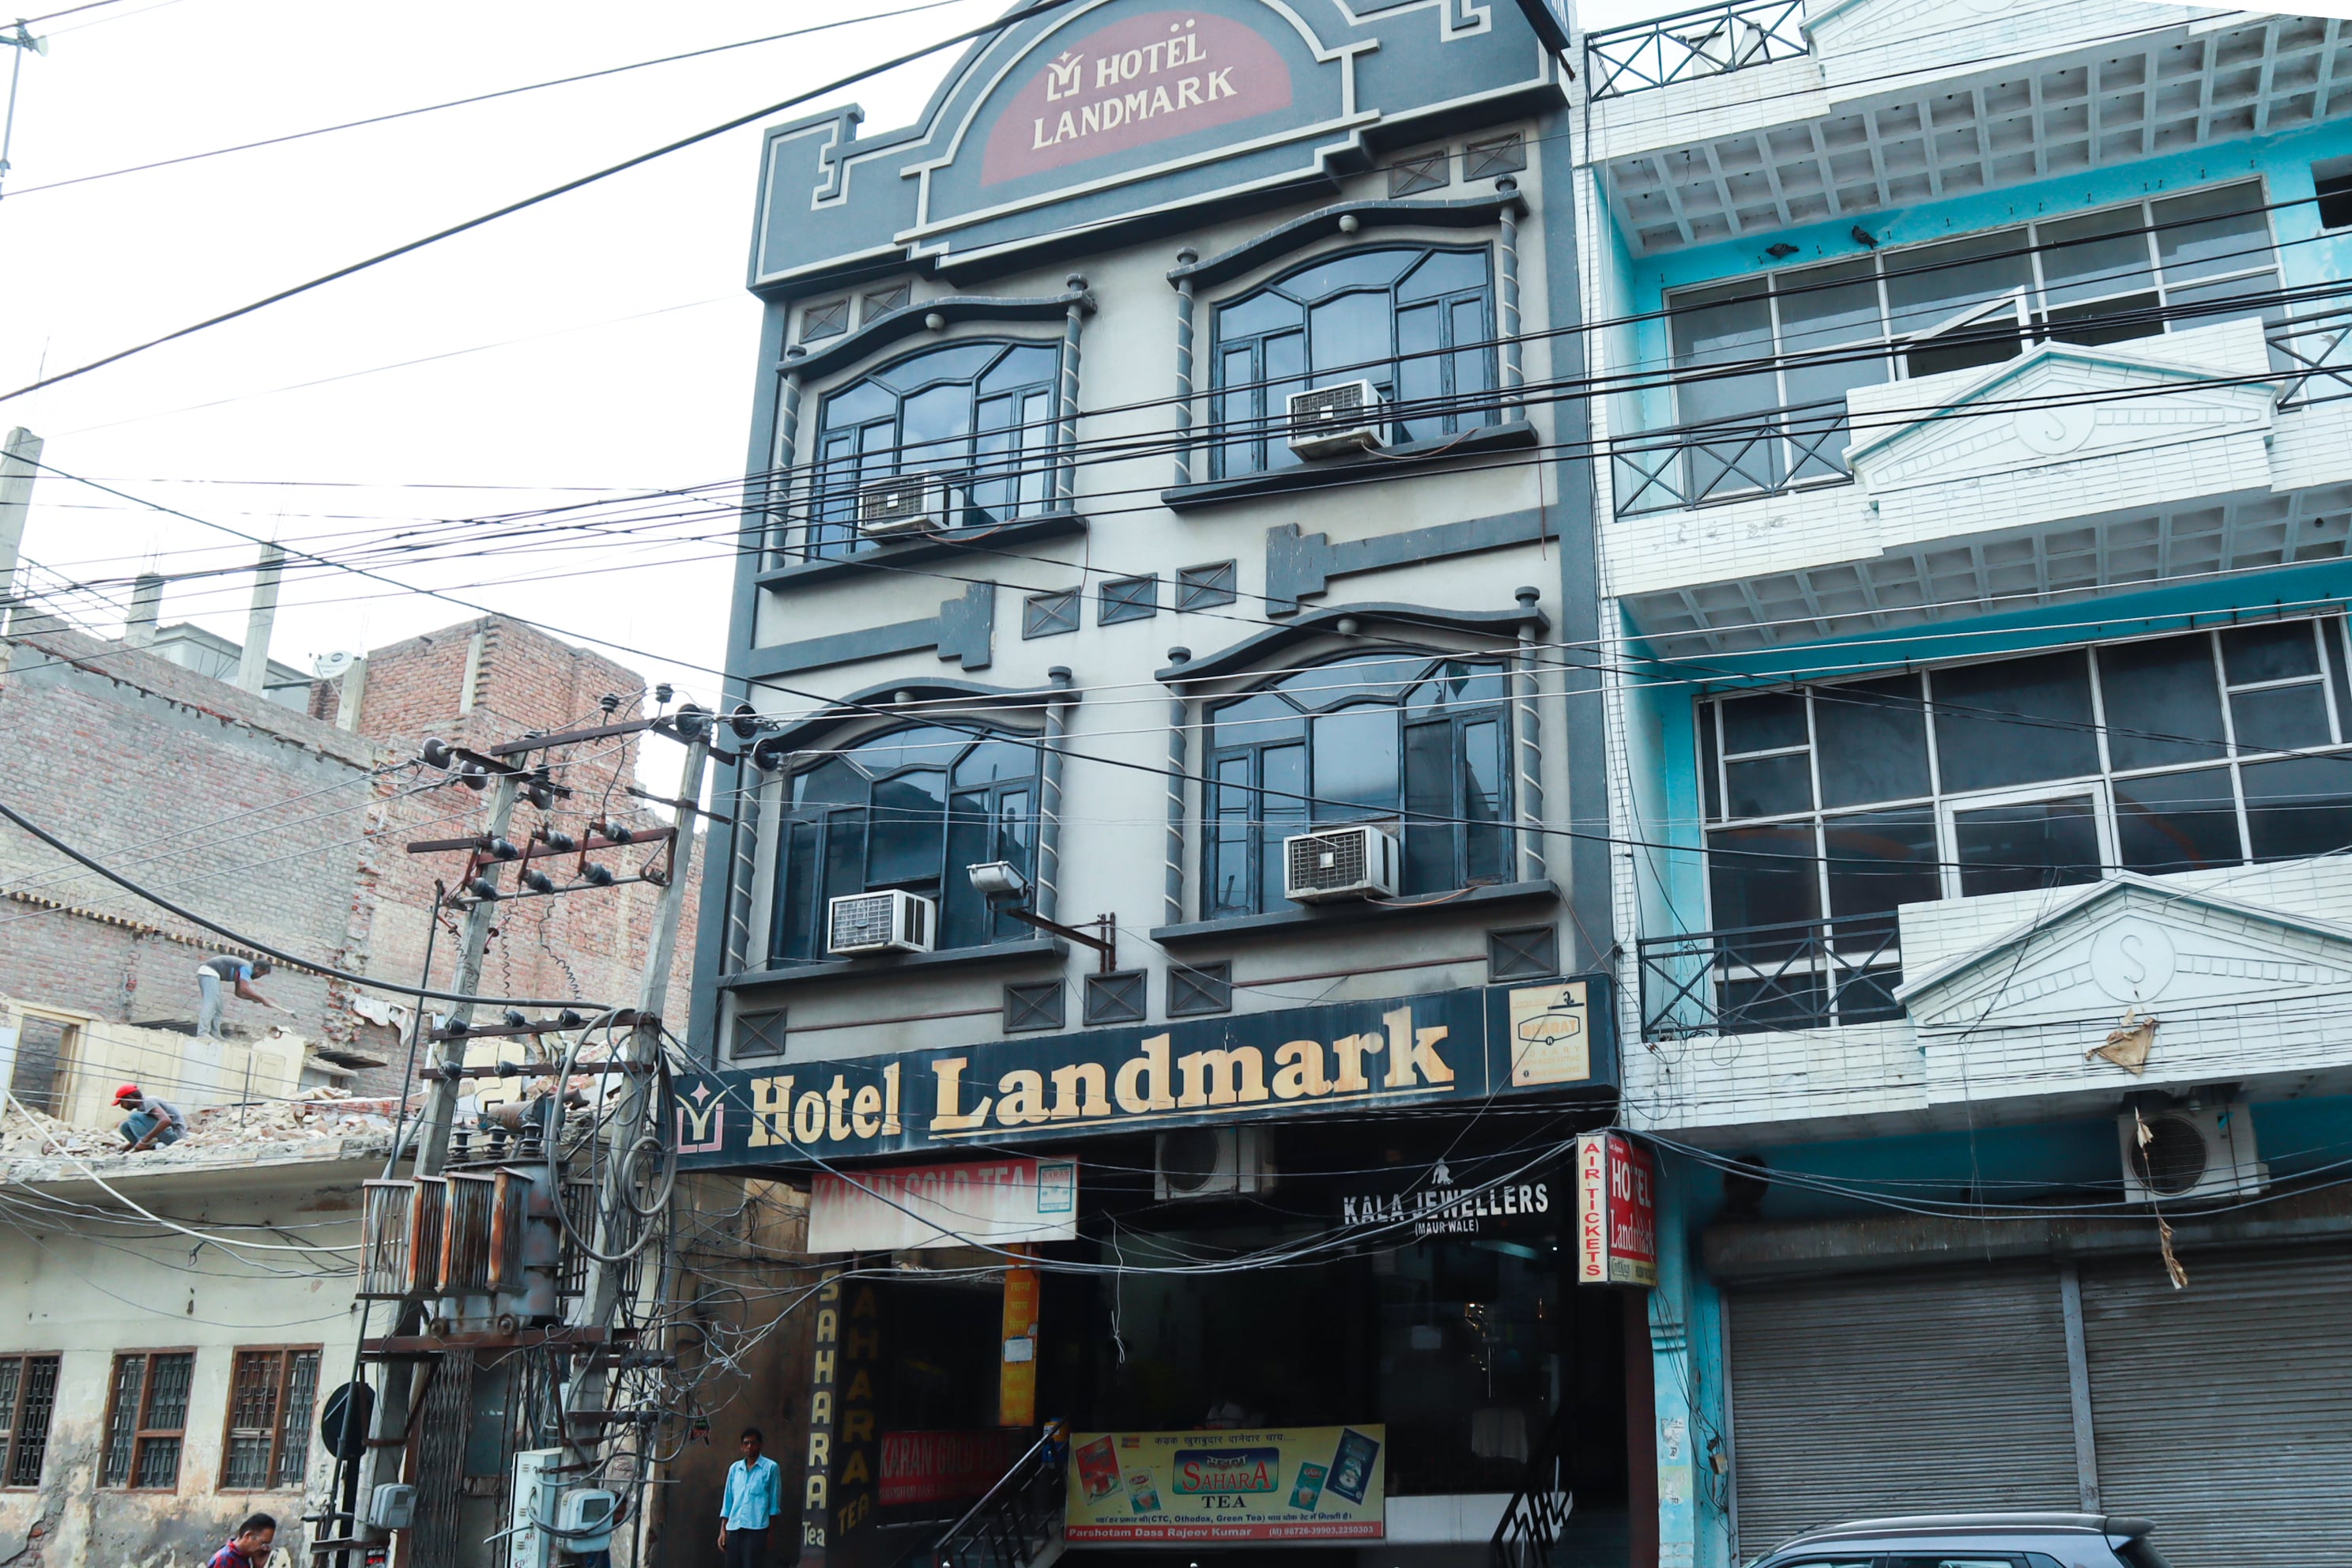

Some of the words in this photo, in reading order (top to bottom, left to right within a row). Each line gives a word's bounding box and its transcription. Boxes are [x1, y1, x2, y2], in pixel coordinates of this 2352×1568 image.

[1031, 66, 1238, 151] LANDMARK
[747, 1061, 903, 1148] Hotel
[930, 1005, 1454, 1133] Landmark
[1583, 1142, 1601, 1180] AIR
[812, 1173, 896, 1213] KARAN
[905, 1170, 971, 1209] GOLD
[978, 1165, 1025, 1203] TEA
[1344, 1194, 1404, 1226] KALA
[1411, 1184, 1549, 1222] JEWELLERS
[1414, 1218, 1446, 1237] (MAUR
[1447, 1218, 1479, 1234] WALE)
[1584, 1188, 1602, 1276] TICKETS
[1610, 1208, 1655, 1256] Landmark
[805, 1268, 840, 1510] SAHARA
[880, 1437, 933, 1478] KARAN
[1182, 1461, 1272, 1492] SAHARA
[838, 1494, 869, 1536] TEA
[1174, 1515, 1214, 1524] Othodox,
[1246, 1513, 1265, 1523] Tea)
[1201, 1494, 1247, 1509] TEA
[801, 1521, 826, 1547] Tea
[1069, 1528, 1131, 1537] Parshotam
[1135, 1528, 1164, 1537] Dass
[1167, 1527, 1208, 1539] Rajeev
[1212, 1526, 1252, 1536] Kumar
[1268, 1527, 1282, 1537] (M)
